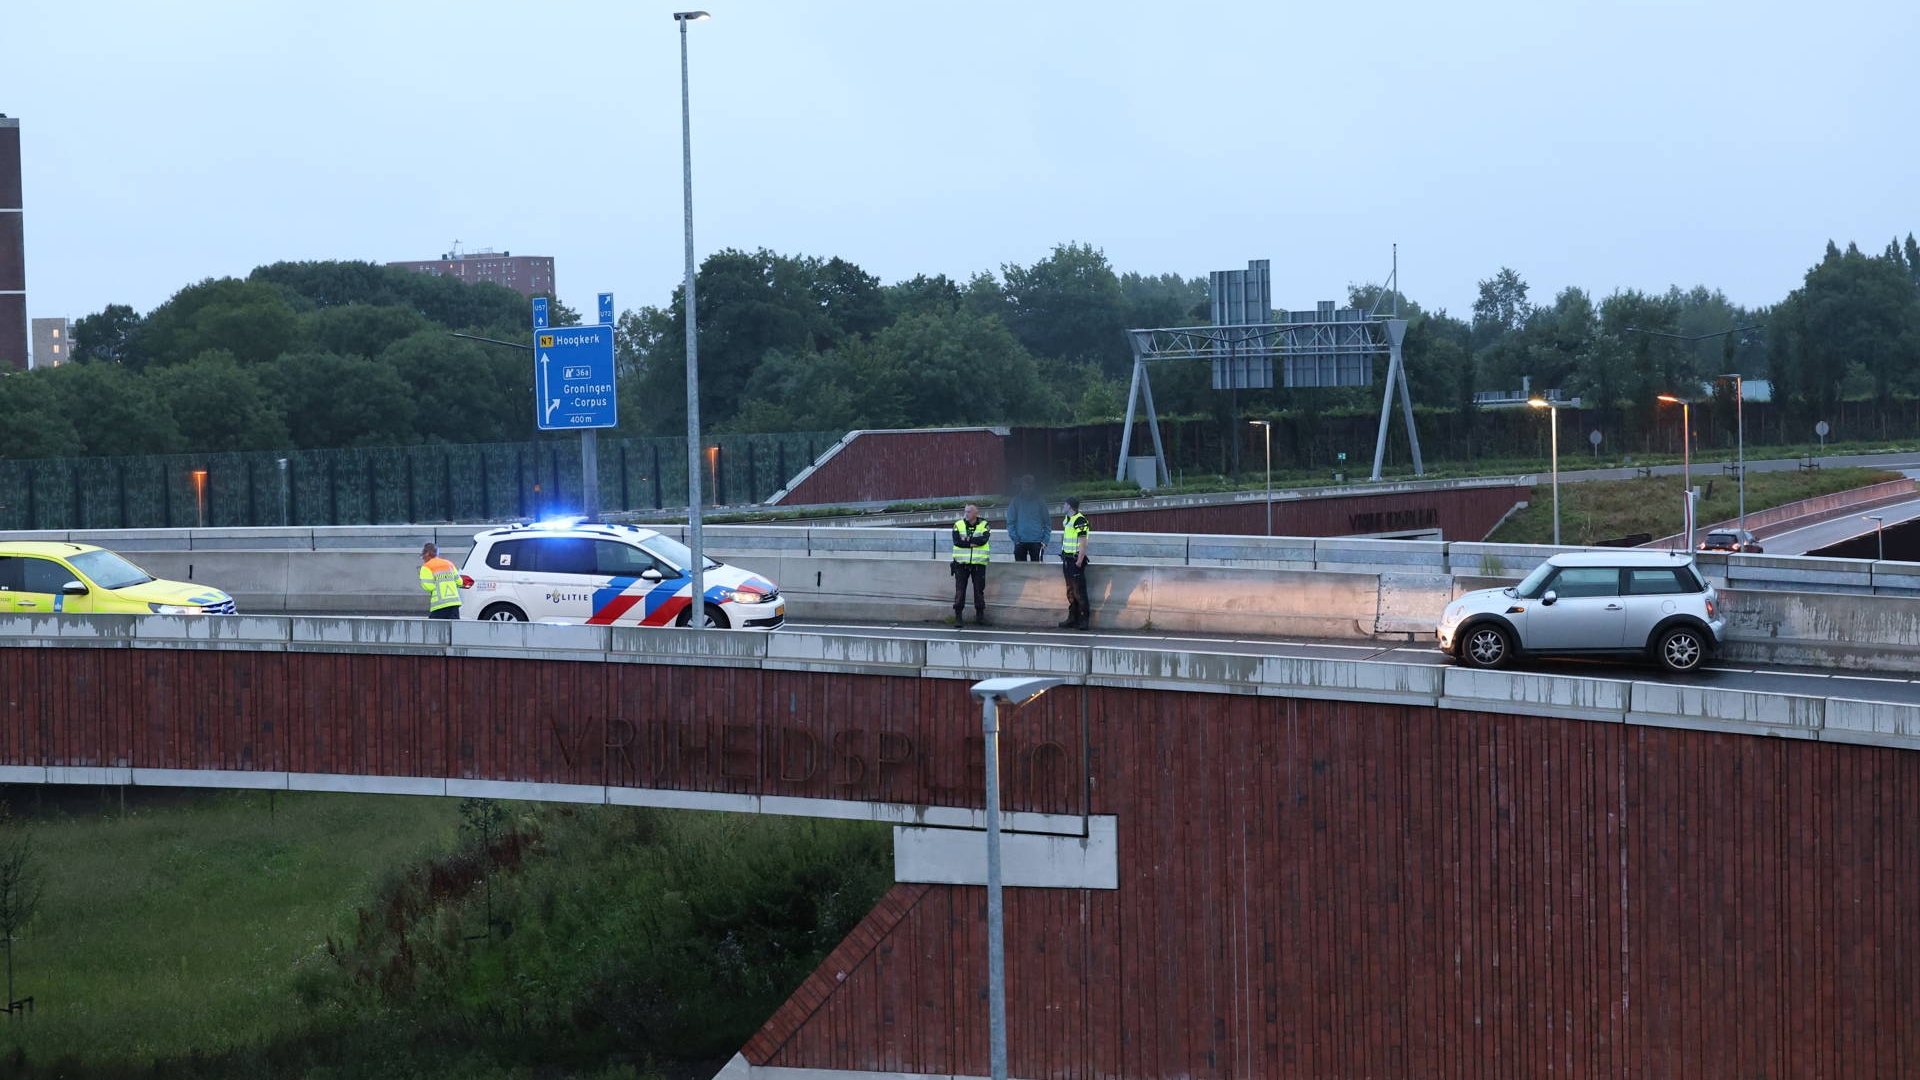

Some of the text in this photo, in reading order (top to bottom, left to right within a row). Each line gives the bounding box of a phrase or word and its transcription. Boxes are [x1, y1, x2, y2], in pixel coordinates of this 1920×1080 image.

[556, 334, 600, 347] Hoogkerk
[563, 384, 612, 395] Groningen
[546, 592, 588, 603] POLITIE
